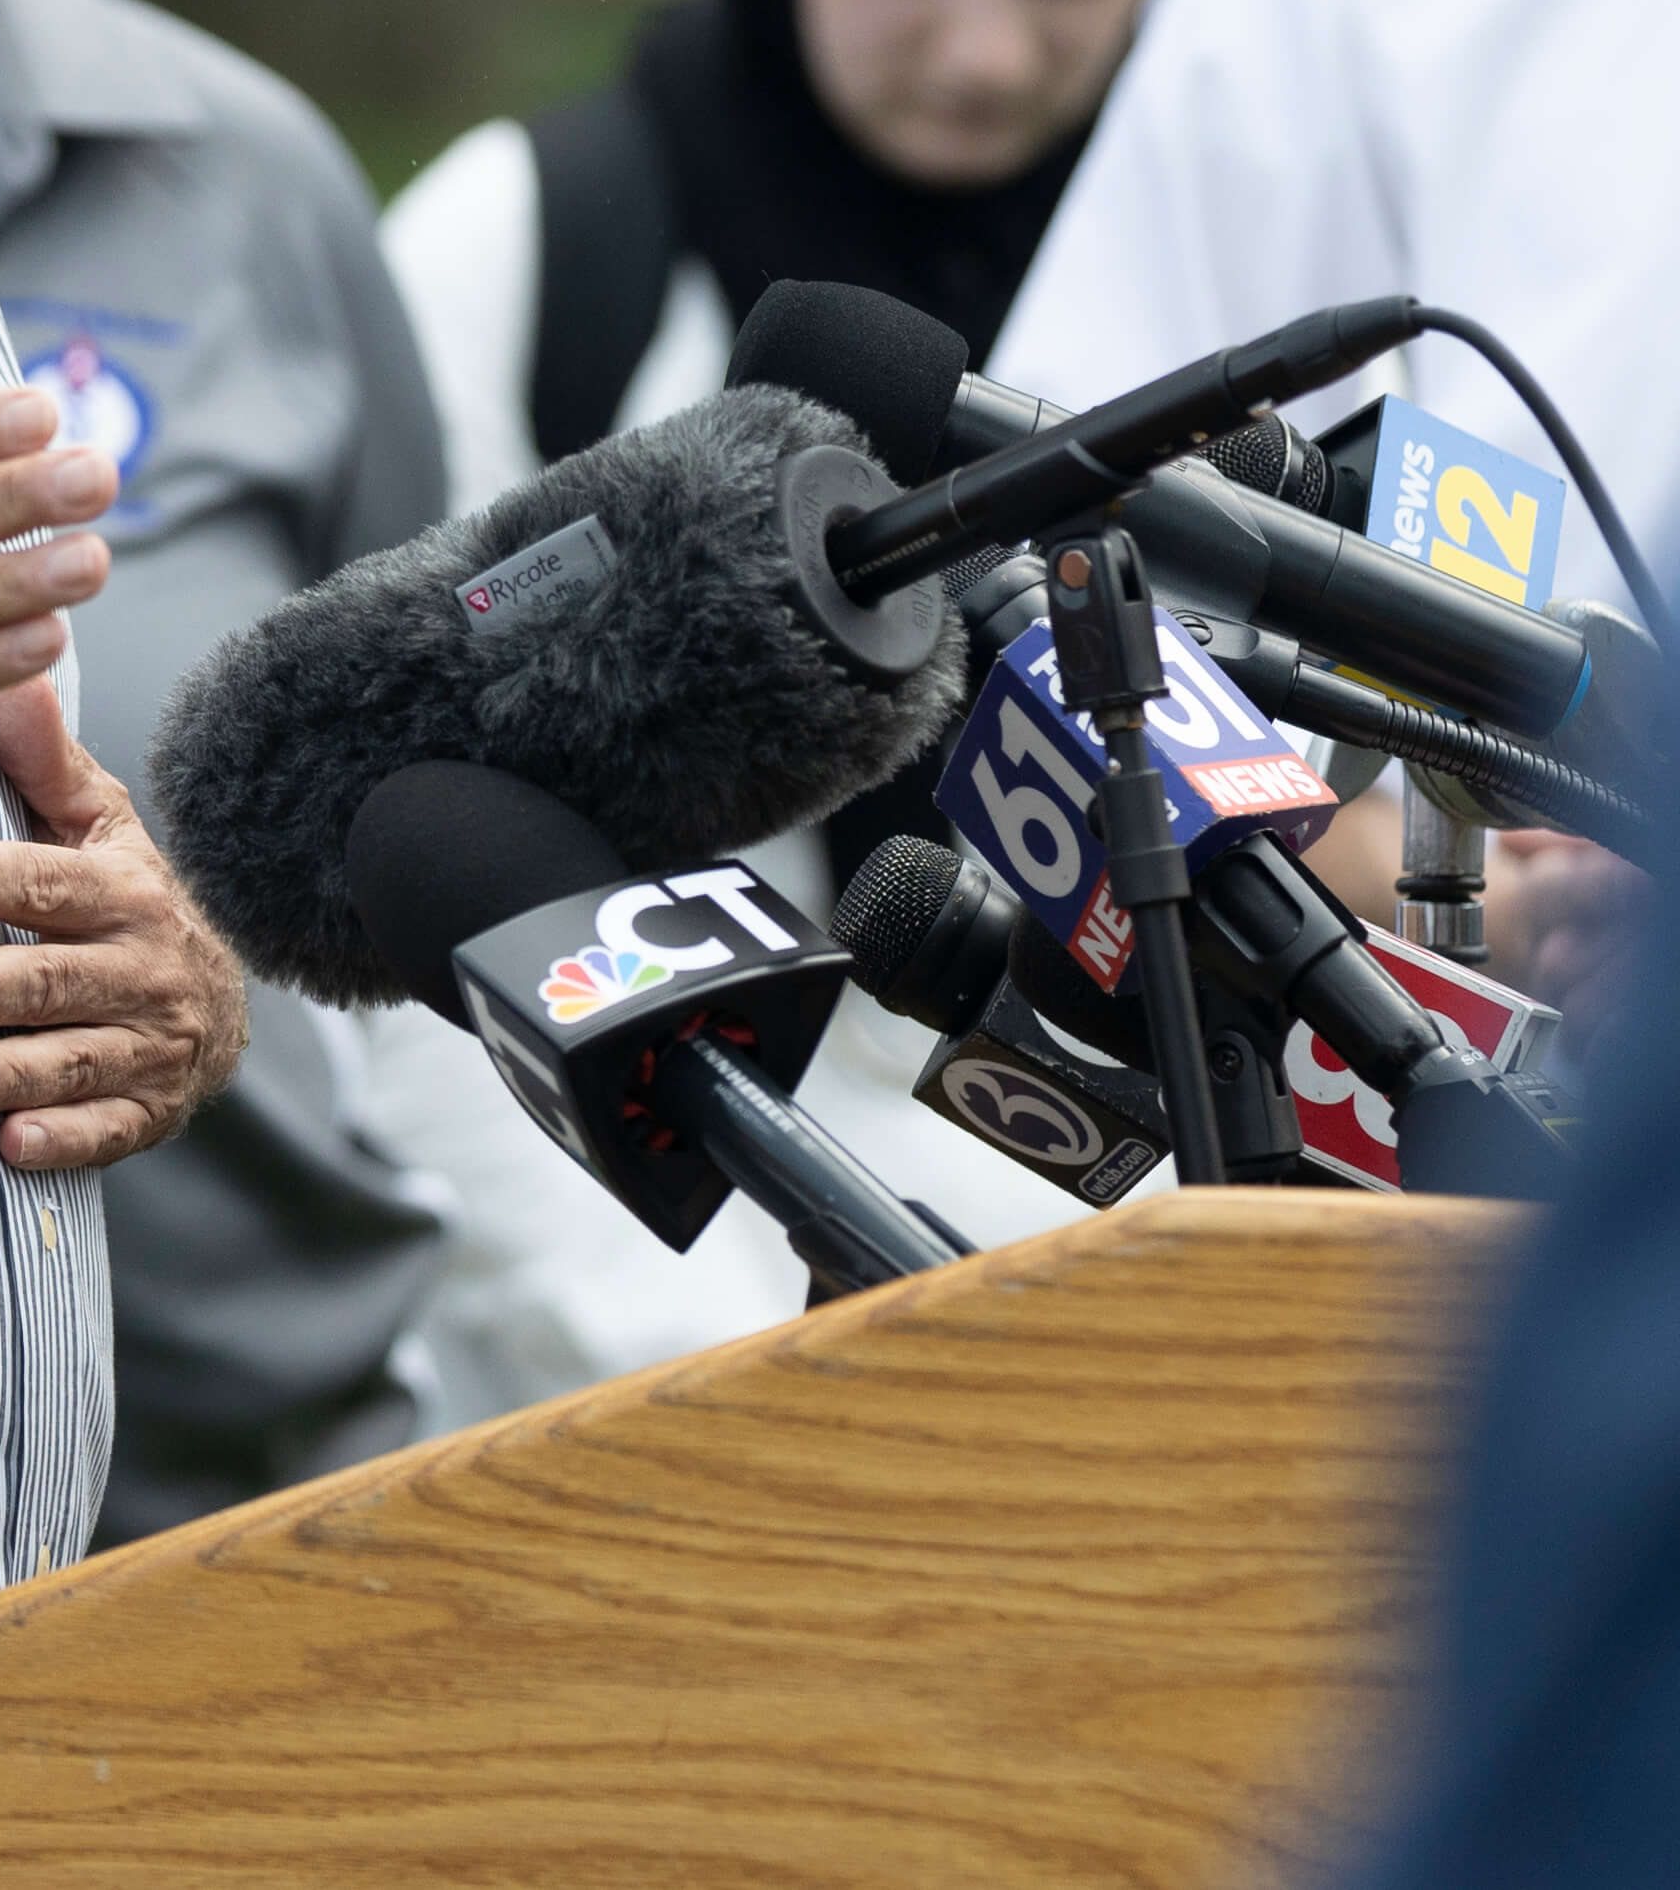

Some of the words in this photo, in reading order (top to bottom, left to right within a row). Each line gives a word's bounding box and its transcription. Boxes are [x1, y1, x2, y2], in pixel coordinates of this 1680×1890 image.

[1390, 439, 1435, 559] news
[1429, 465, 1538, 606] 12
[488, 552, 564, 606] Rycote
[970, 694, 1098, 898] 61
[1195, 759, 1323, 807] NEWS
[594, 866, 800, 971] CT
[1091, 1144, 1149, 1196] wfsb.com
